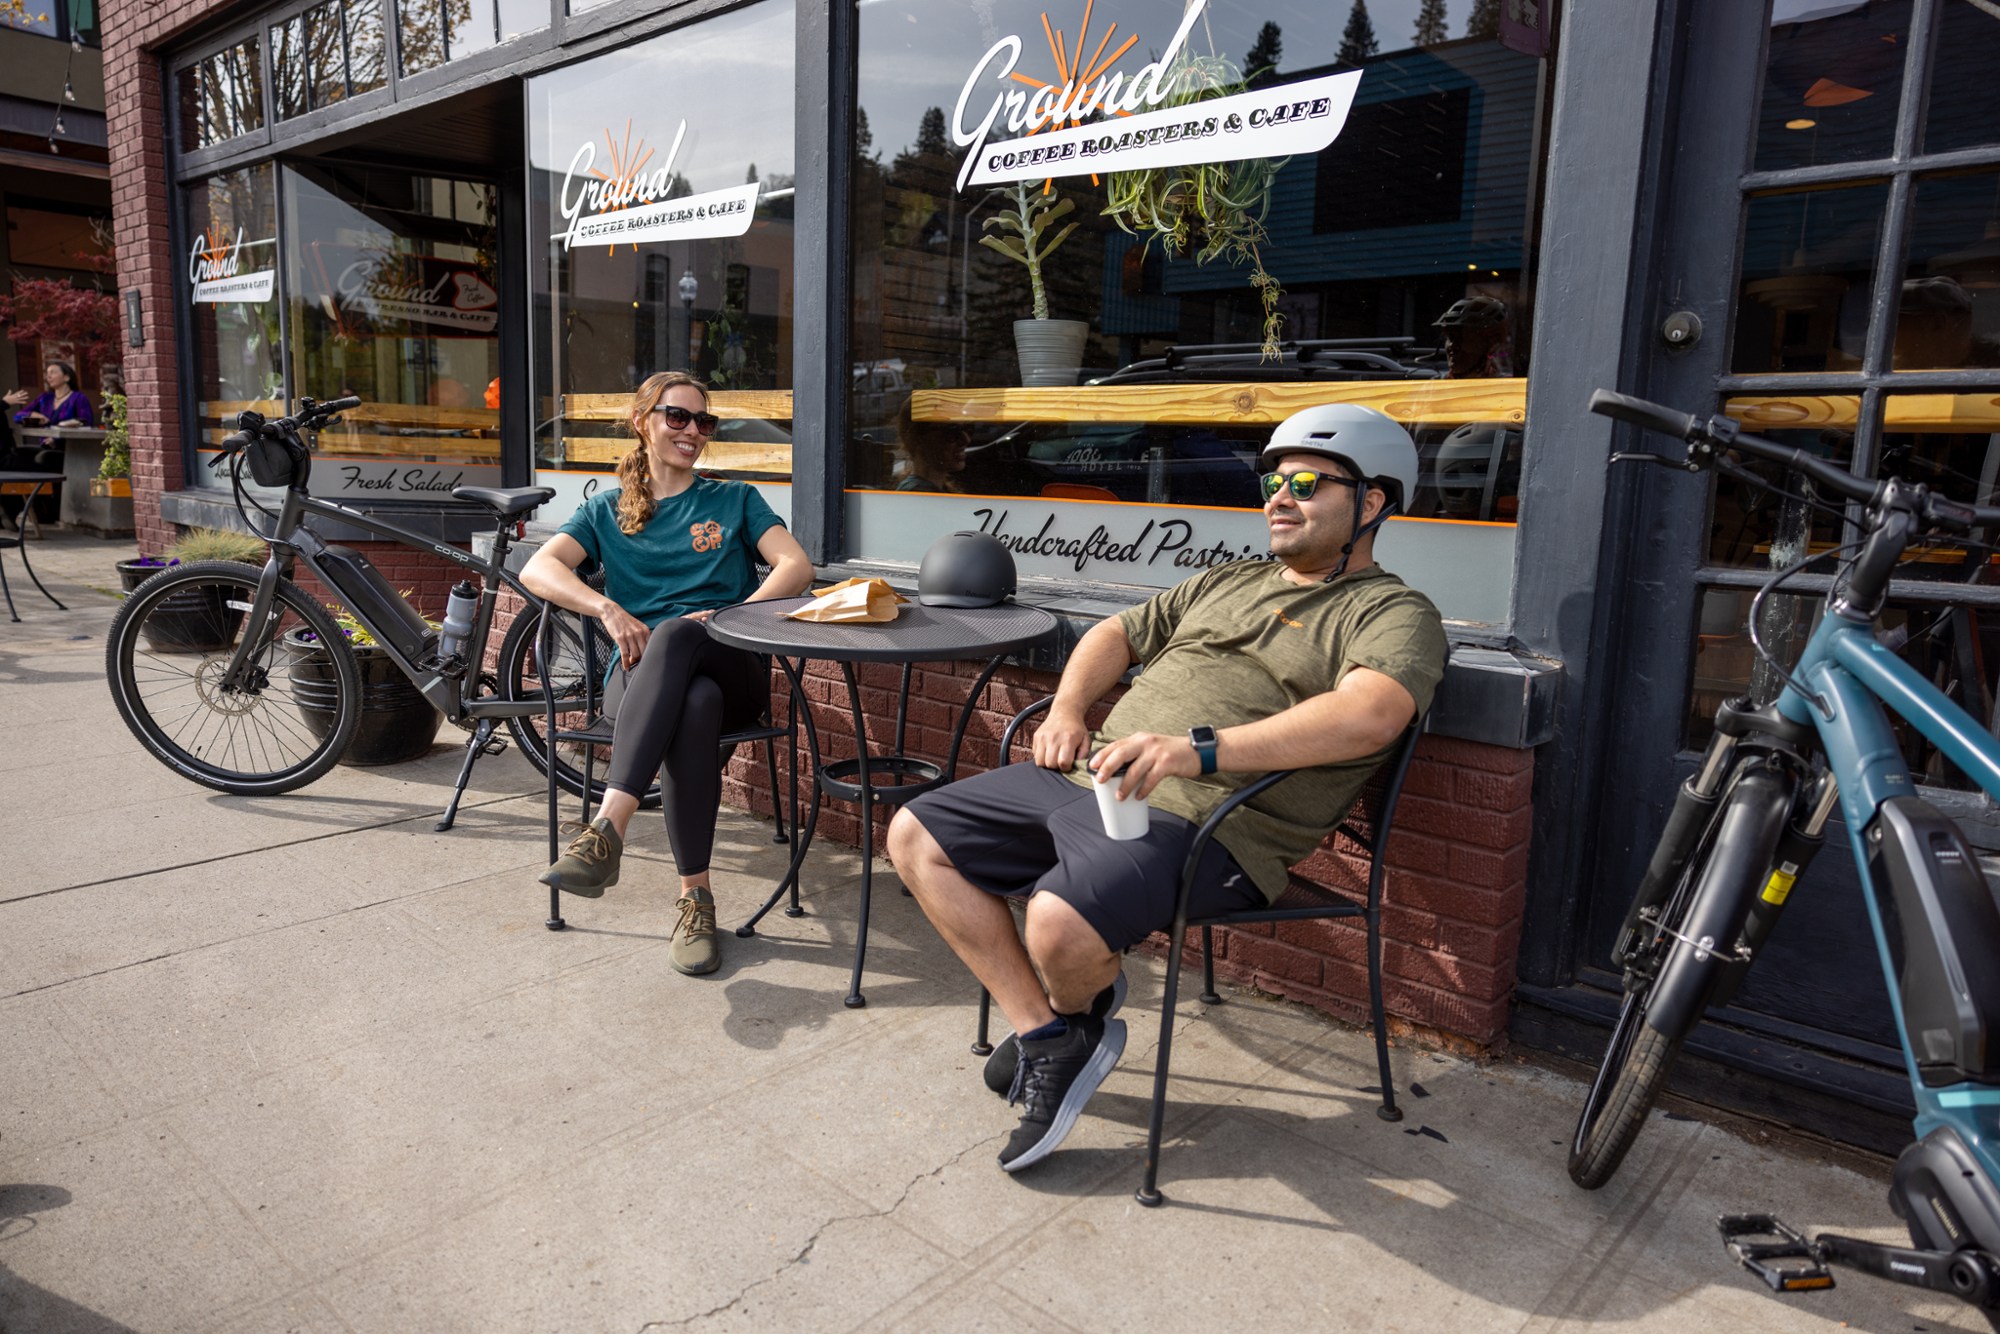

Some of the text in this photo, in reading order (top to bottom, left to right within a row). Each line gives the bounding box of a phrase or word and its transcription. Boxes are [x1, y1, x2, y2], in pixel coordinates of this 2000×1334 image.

[952, 0, 1206, 193] Ground
[988, 96, 1332, 172] COFFEE ROASTERS & CAFE
[561, 118, 687, 252] Ground
[581, 199, 747, 238] COFFEE ROASTERS & CAFE
[189, 226, 243, 305] Ground
[200, 285, 220, 297] COFFEE
[254, 279, 269, 290] CAFE
[337, 260, 450, 311] Ground
[341, 466, 398, 490] Fresh
[973, 508, 1155, 572] Handcrafted
